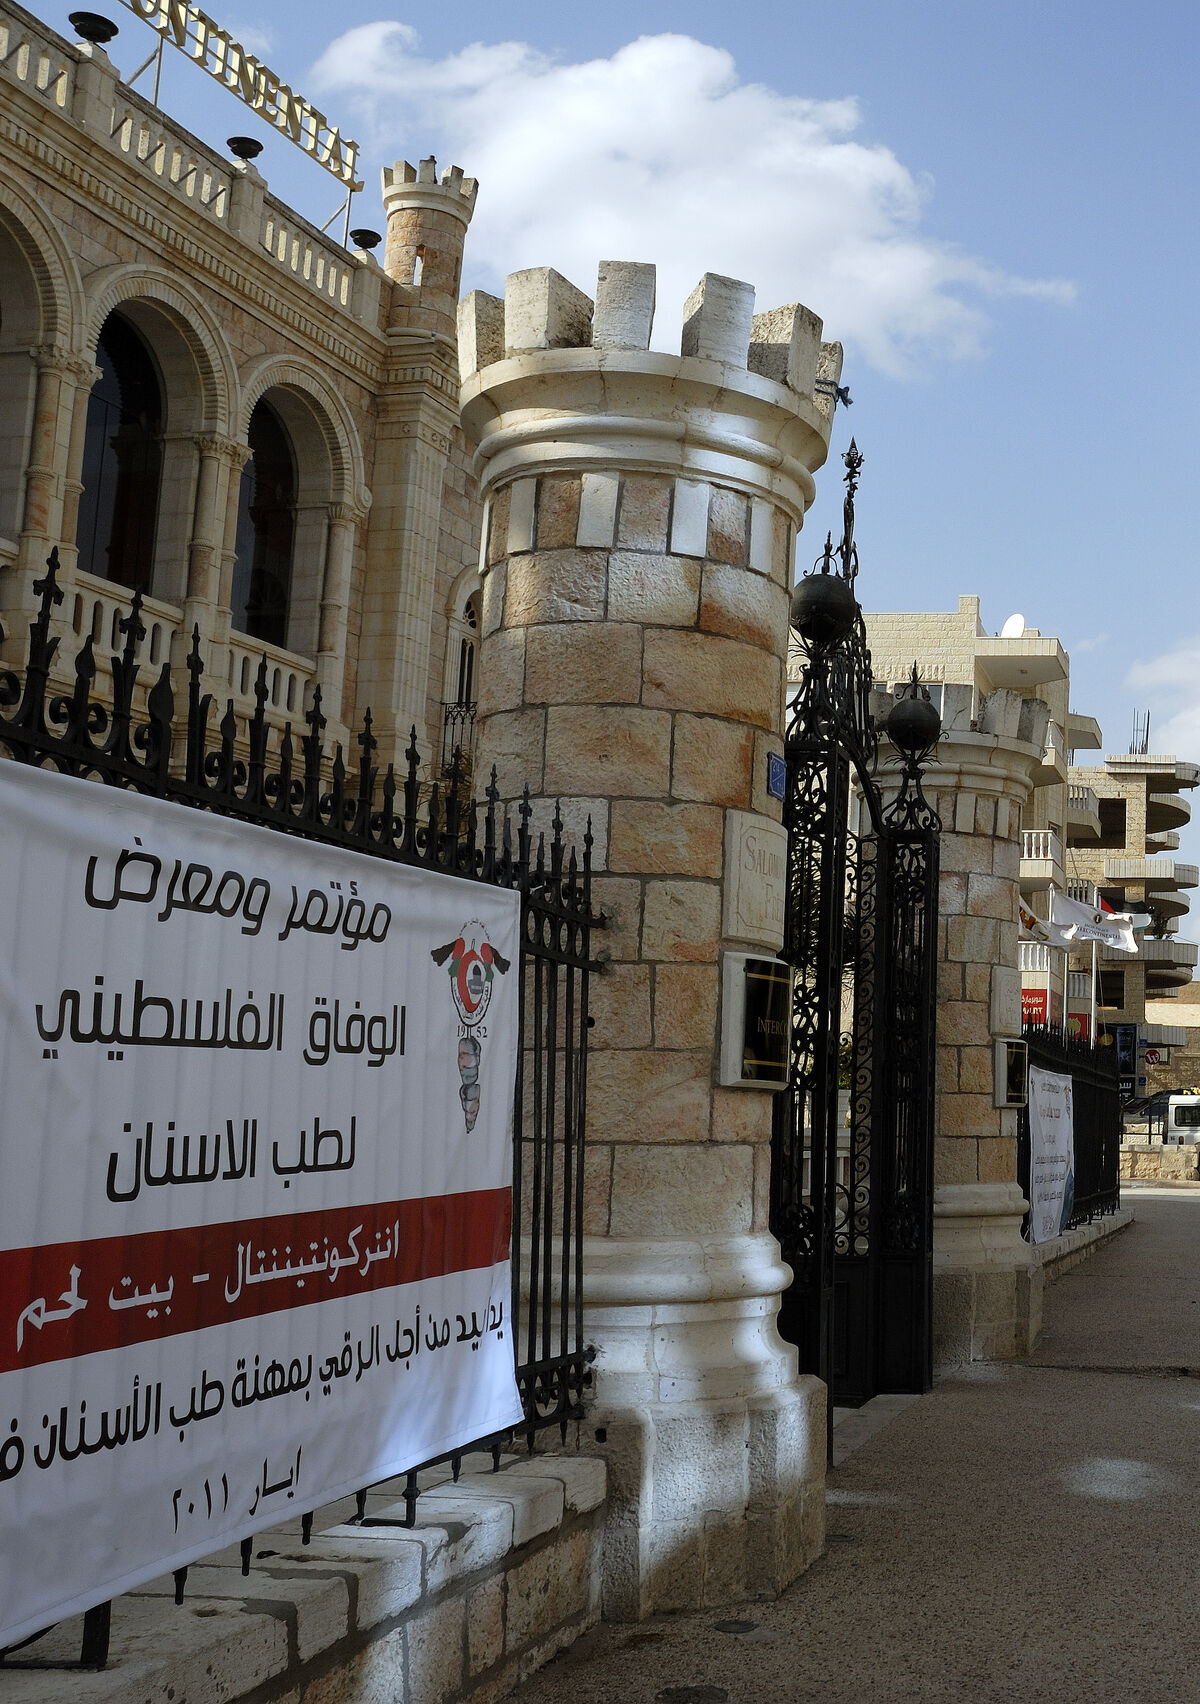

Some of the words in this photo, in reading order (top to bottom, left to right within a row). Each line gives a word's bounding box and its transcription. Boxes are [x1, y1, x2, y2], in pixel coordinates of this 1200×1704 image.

[85, 837, 270, 936] ومعرض
[279, 881, 391, 951] مؤتمر
[36, 976, 284, 1060] الفلسطيني
[303, 997, 405, 1067] الوفاق
[457, 1025, 466, 1037] 19
[476, 1026, 488, 1038] 52
[107, 1119, 257, 1202] الاسنان
[273, 1116, 356, 1188] لطب
[17, 1264, 88, 1352] لحم
[109, 1276, 174, 1319] بيت
[425, 1314, 451, 1352] من
[319, 1325, 381, 1397] الرقي
[386, 1305, 421, 1370] أجل
[170, 1370, 225, 1442] طب
[232, 1355, 312, 1408] بمهنة
[34, 1375, 161, 1470] الأسنان
[172, 1473, 229, 1533] ٢٠١١
